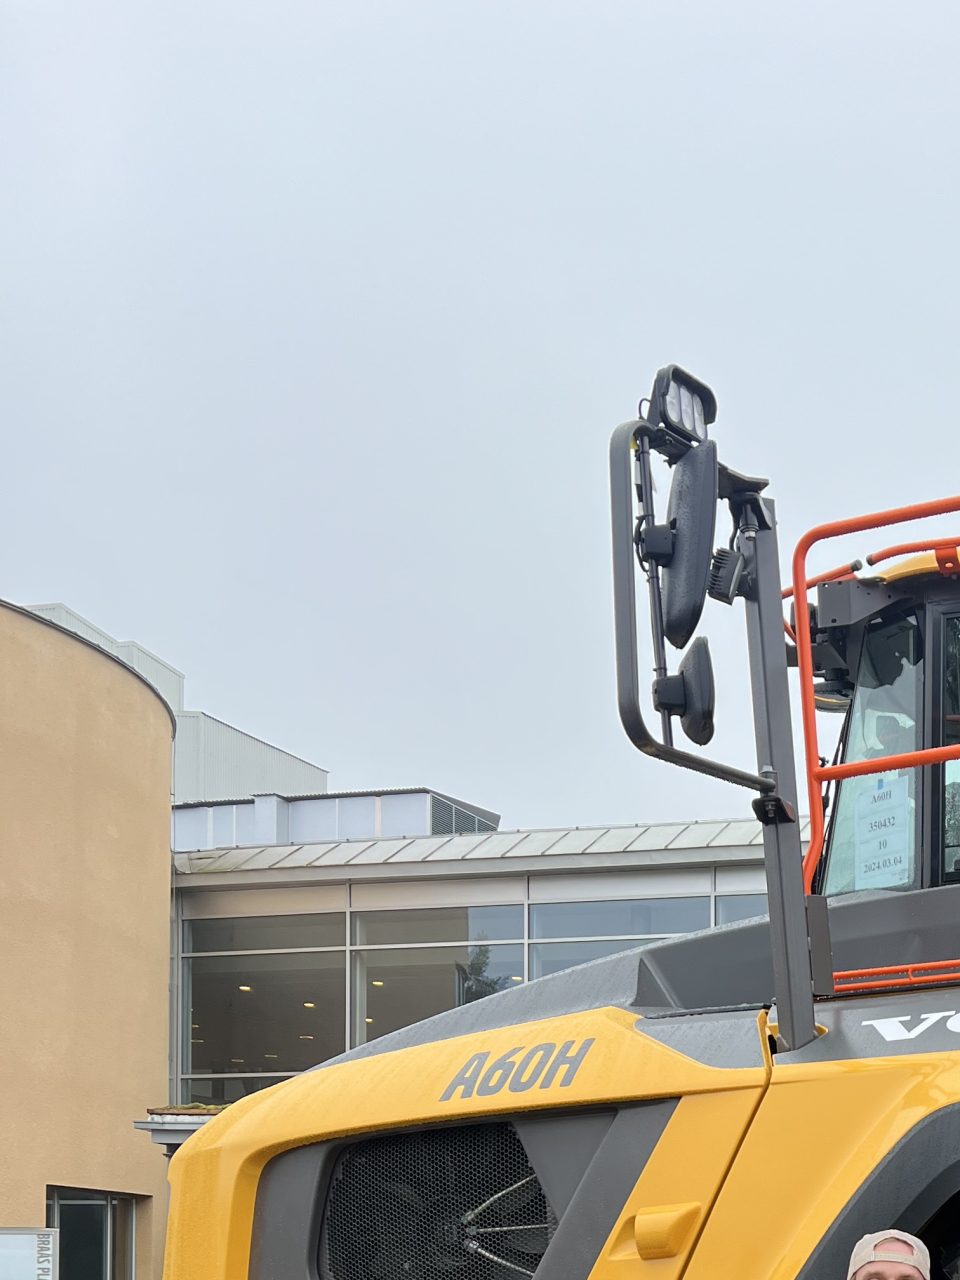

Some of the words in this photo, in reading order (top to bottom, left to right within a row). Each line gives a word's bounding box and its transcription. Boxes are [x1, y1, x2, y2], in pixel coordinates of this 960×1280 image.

[870, 790, 892, 804] A60H
[868, 816, 896, 832] 350432
[878, 839, 888, 850] 10
[863, 856, 902, 874] 2024.03.04
[438, 1038, 596, 1102] A60H
